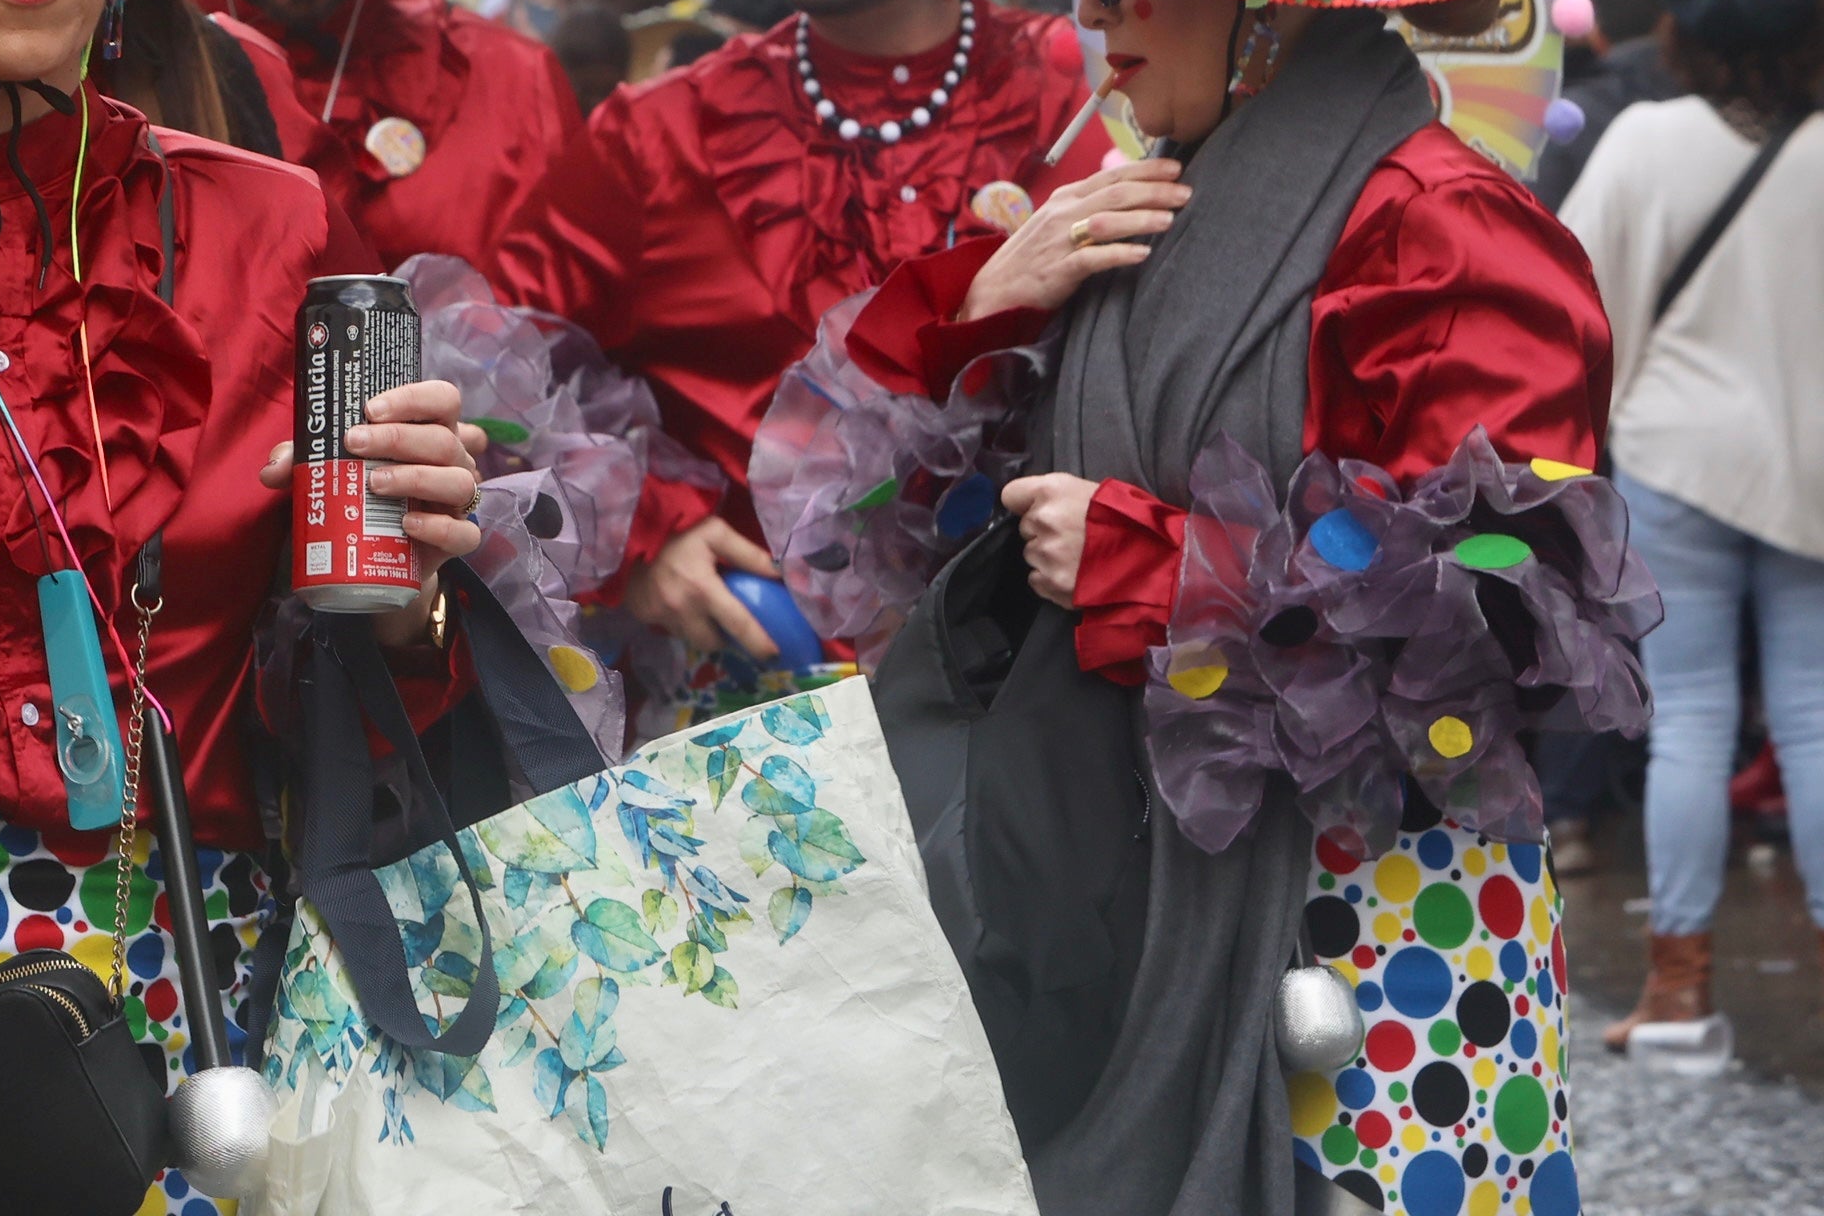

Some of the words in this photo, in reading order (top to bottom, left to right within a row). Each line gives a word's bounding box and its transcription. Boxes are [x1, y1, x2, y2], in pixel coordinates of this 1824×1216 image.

[307, 351, 326, 434] Galicia
[307, 437, 325, 527] Estrella
[346, 483, 357, 496] 50
